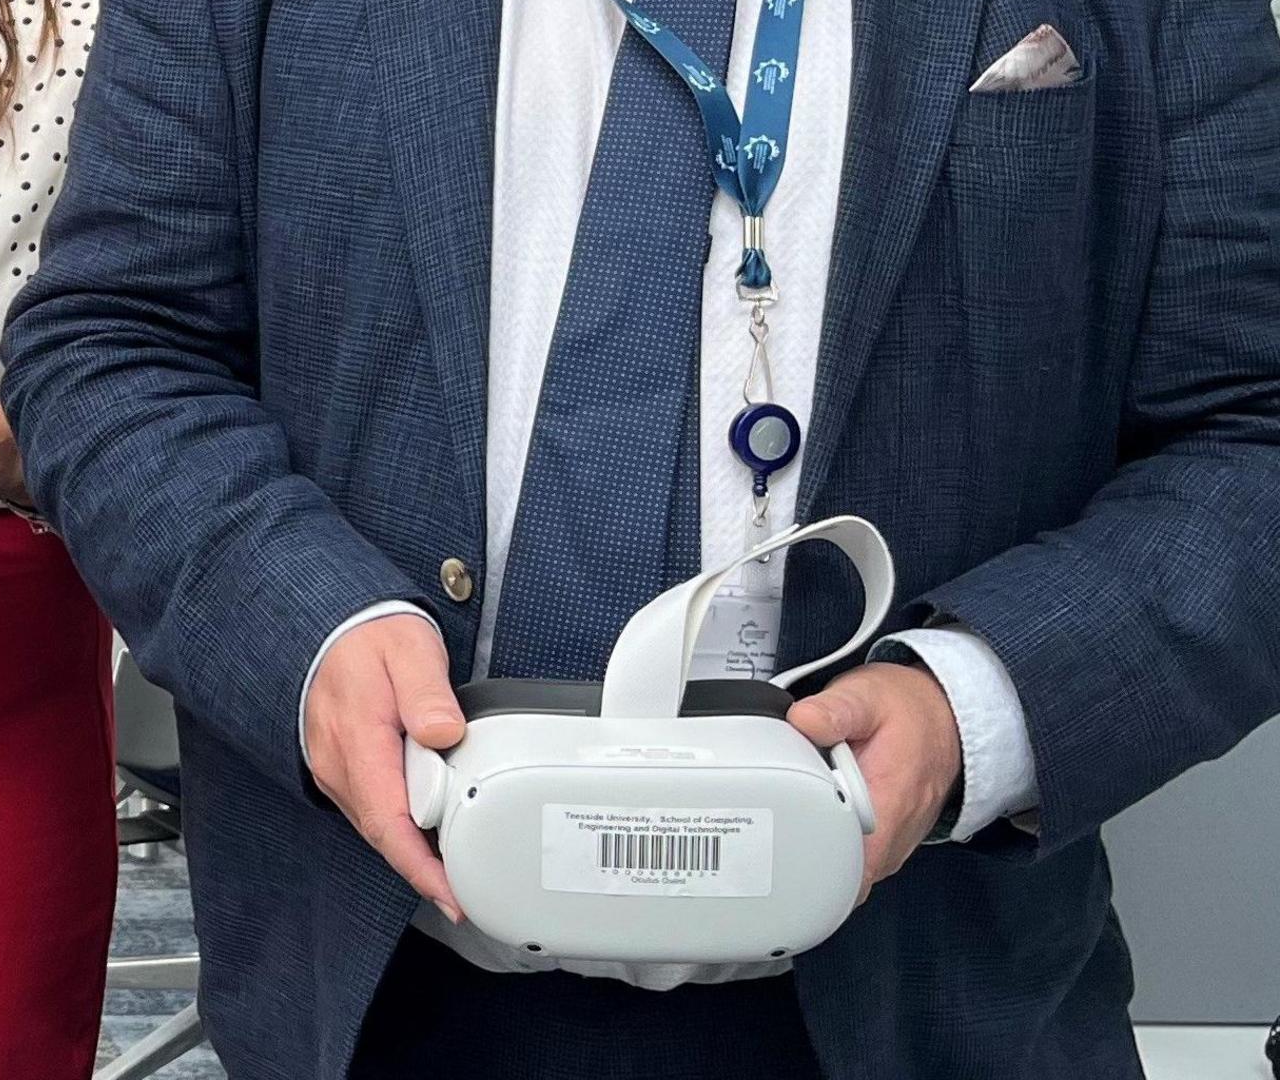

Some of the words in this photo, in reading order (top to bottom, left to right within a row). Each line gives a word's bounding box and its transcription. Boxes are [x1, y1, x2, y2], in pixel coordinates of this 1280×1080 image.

[660, 816, 691, 824] School
[578, 822, 632, 832] Engineering
[652, 825, 680, 834] Digital
[683, 826, 741, 834] Technologies
